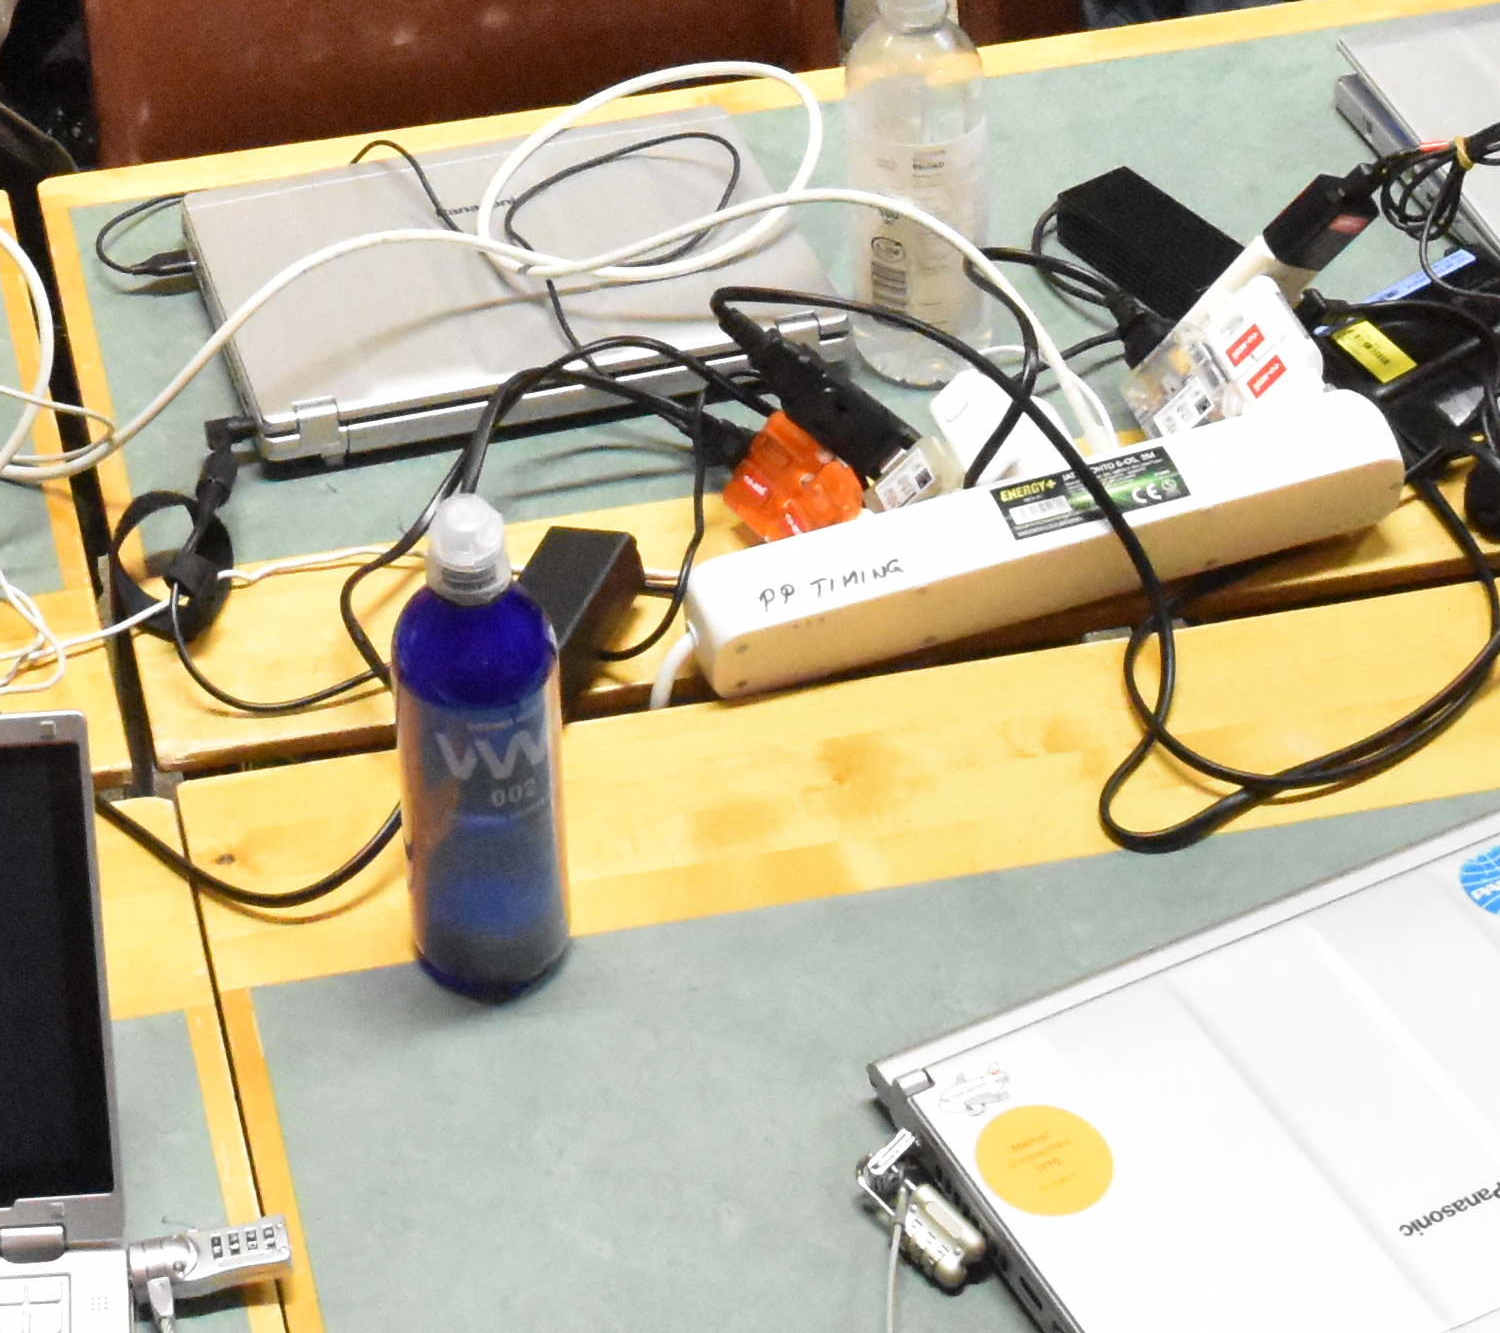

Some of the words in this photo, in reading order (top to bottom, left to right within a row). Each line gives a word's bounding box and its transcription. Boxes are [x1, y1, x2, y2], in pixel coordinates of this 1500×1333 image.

[999, 478, 1058, 503] ENERGY+
[809, 558, 905, 599] TIMING
[491, 776, 537, 807] 002
